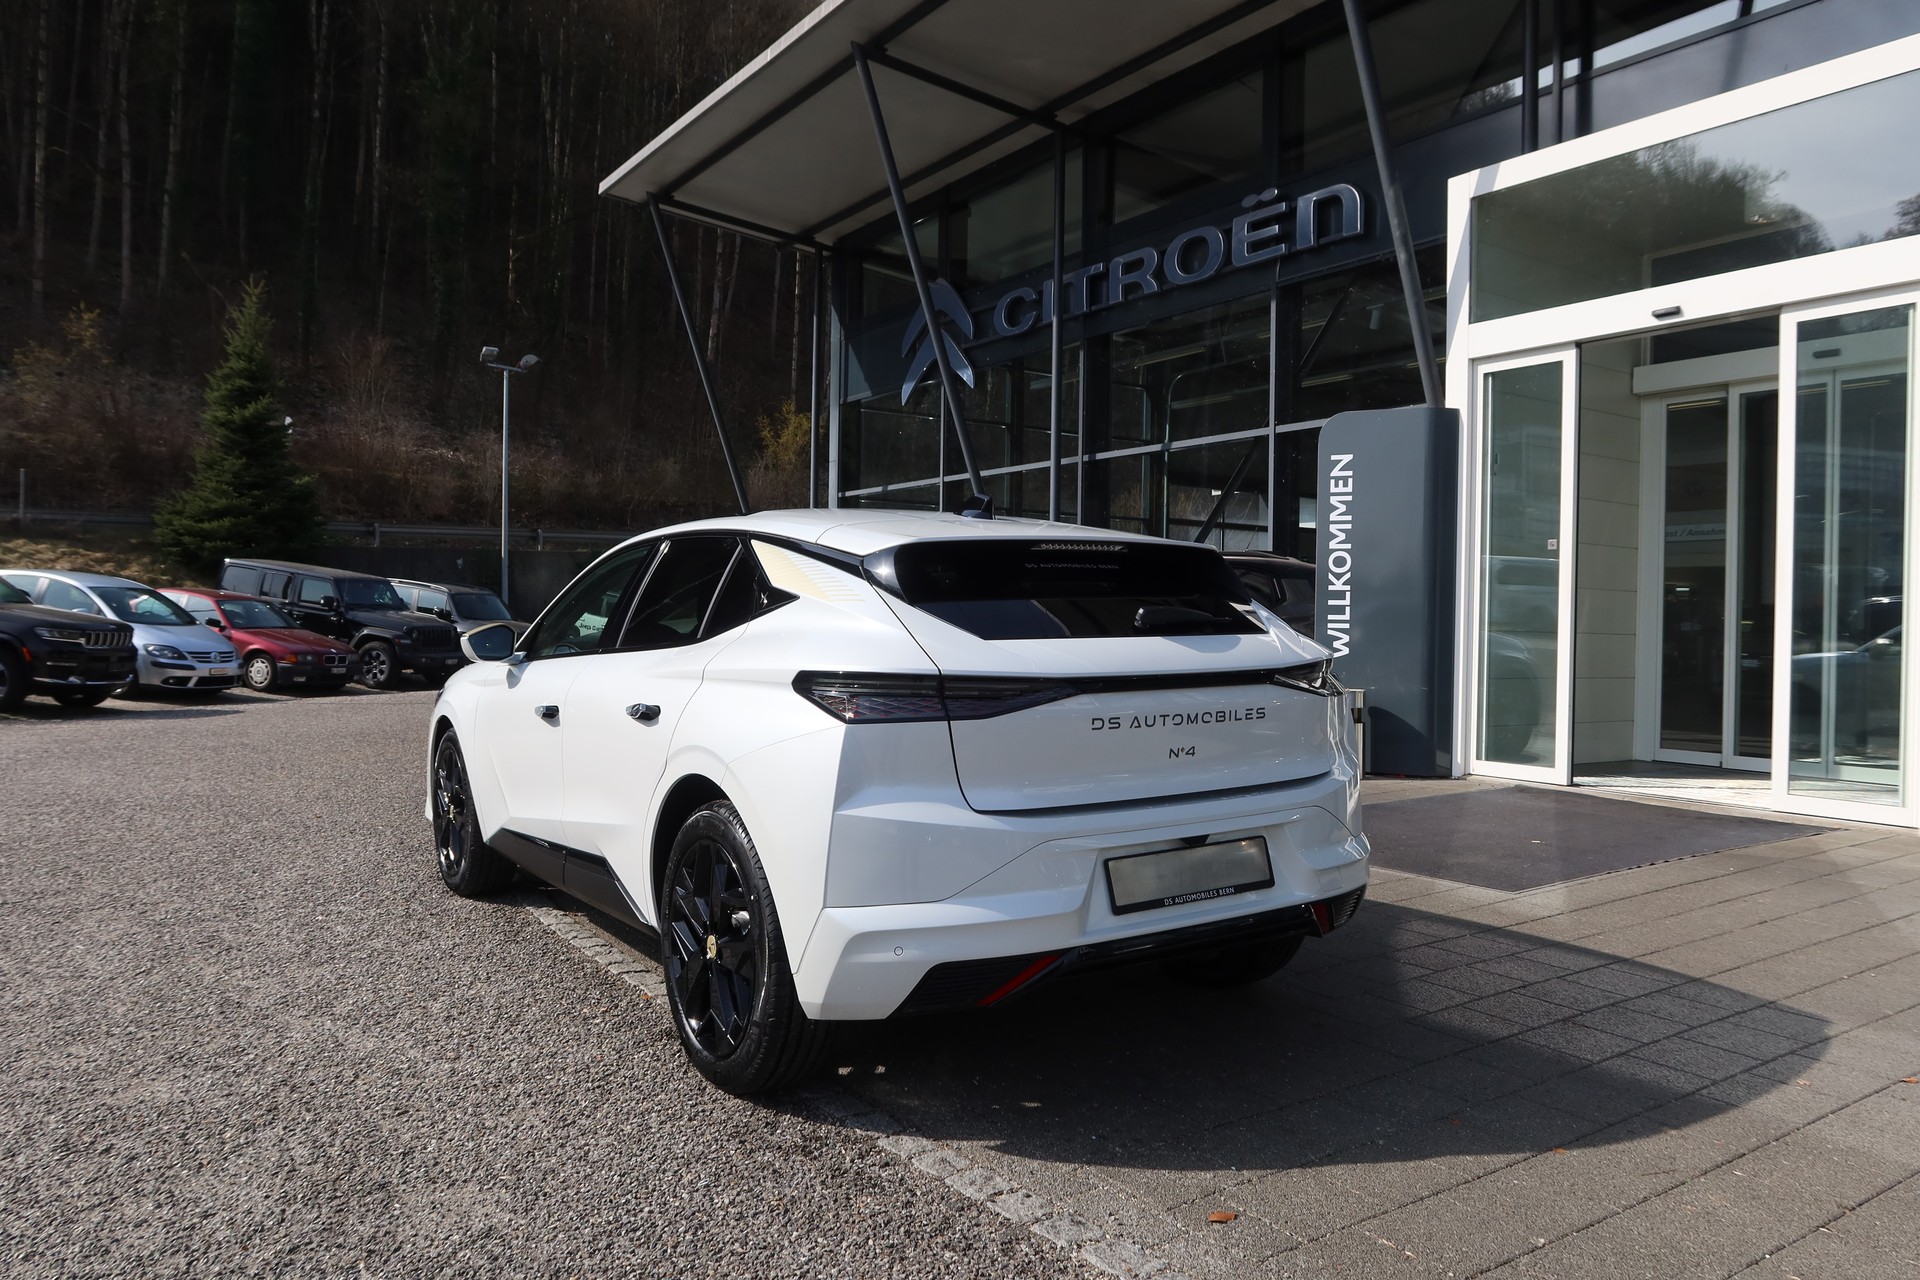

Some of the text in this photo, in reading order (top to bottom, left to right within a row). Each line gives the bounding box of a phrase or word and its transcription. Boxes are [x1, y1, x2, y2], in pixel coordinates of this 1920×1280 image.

[1327, 453, 1354, 659] WILLKOMMEN
[1091, 707, 1266, 731] DS AUTOMOBILES
[1164, 887, 1235, 906] DS AUTOMOBILES BERN
